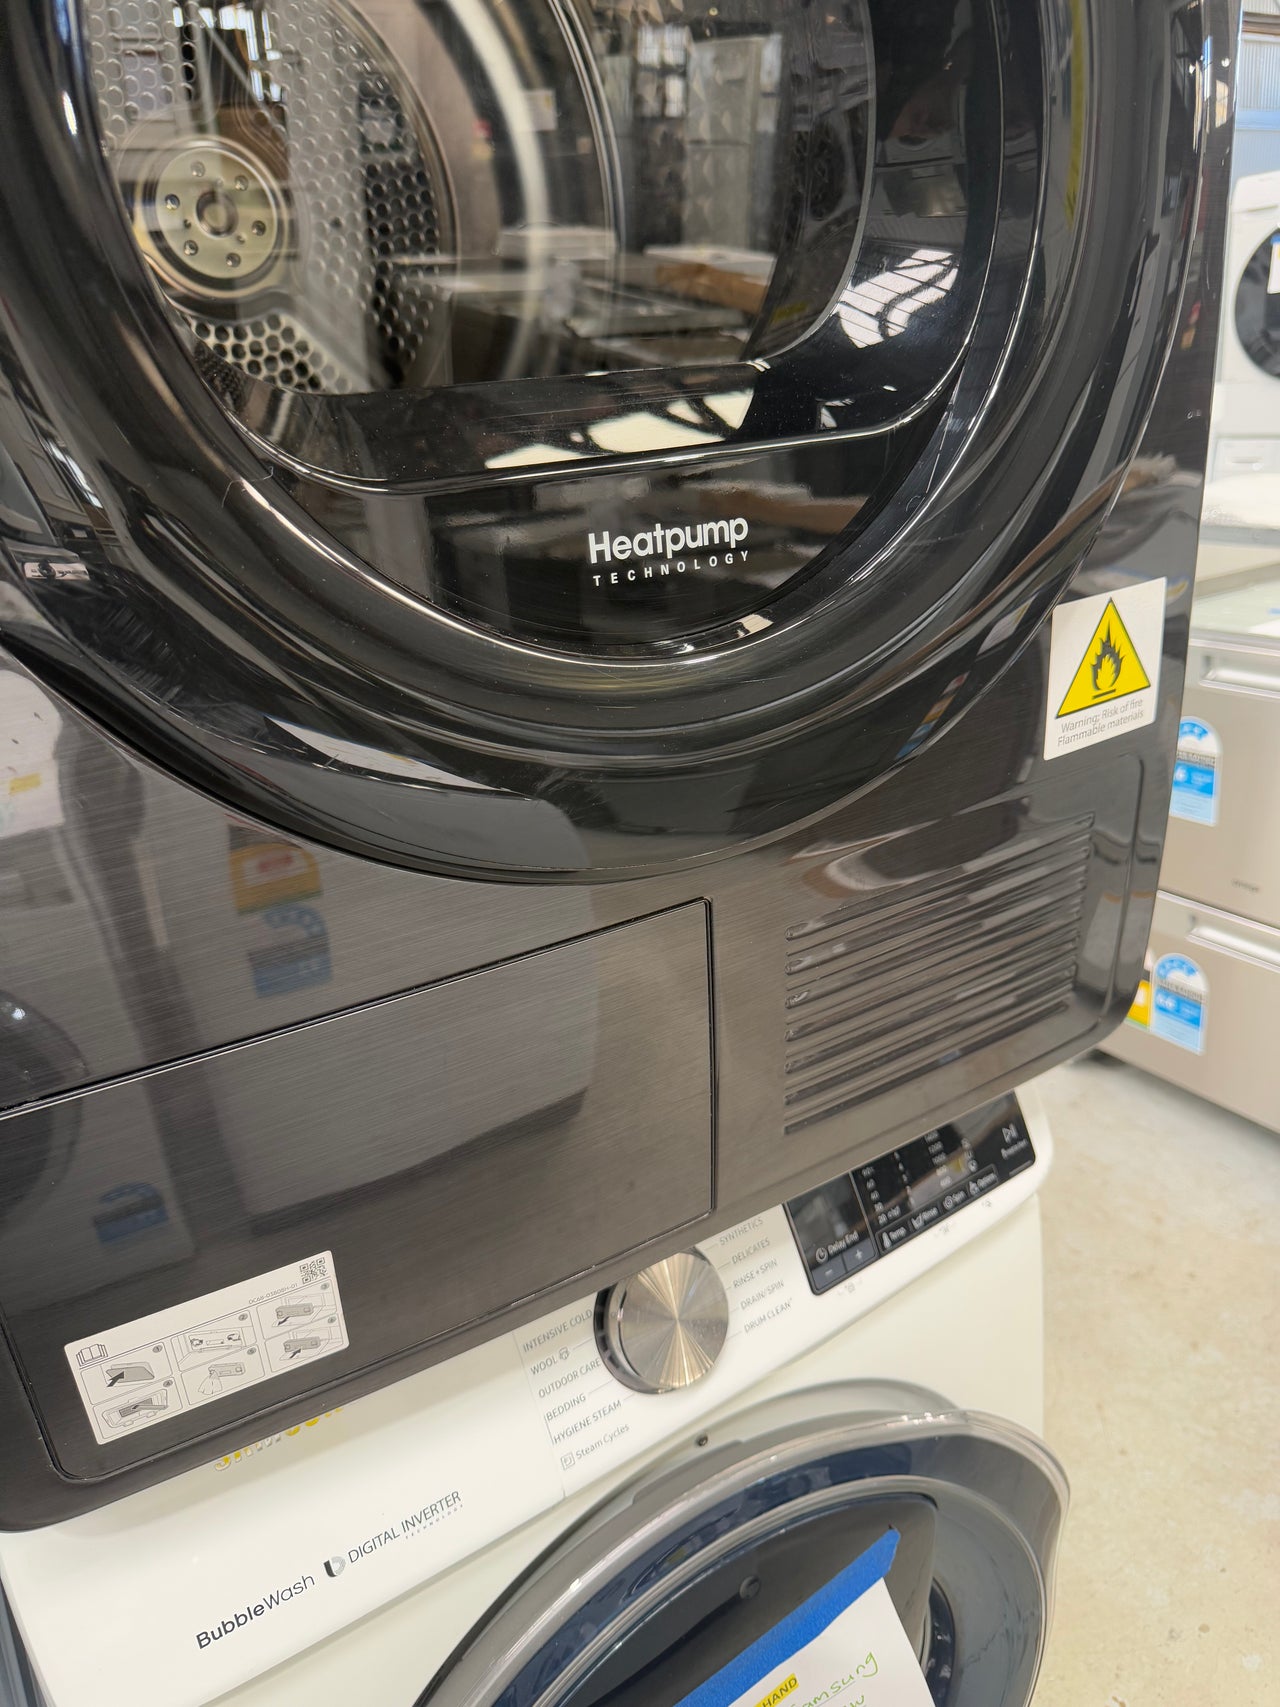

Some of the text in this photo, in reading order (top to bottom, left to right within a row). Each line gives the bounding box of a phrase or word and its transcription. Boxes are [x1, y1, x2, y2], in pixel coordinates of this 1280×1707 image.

[588, 517, 749, 564] Heatpump
[592, 550, 748, 587] TECHNOLOGY
[1101, 703, 1120, 719] Risk
[1120, 700, 1131, 714] of
[1130, 698, 1143, 711] fire
[1057, 709, 1144, 747] Flammable materials
[719, 1216, 764, 1246] SYNTHETICS
[845, 1230, 860, 1246] End
[731, 1237, 771, 1264] DELICATES
[732, 1270, 755, 1289] RINSE
[759, 1258, 778, 1275] SPIN
[522, 1308, 593, 1353] INTENSIVE COLD
[744, 1314, 767, 1333] DRUM
[530, 1356, 558, 1376] WOOL
[538, 1358, 601, 1399] OUTDOOR CARE
[546, 1392, 587, 1422] BEDDING
[553, 1399, 622, 1445] HYGIENE STEAM
[575, 1423, 630, 1460] Steam Cycles
[347, 1490, 462, 1564] DIGITAL INVERTER
[195, 1574, 316, 1650] BubbleWash
[762, 1677, 798, 1707] HAND
